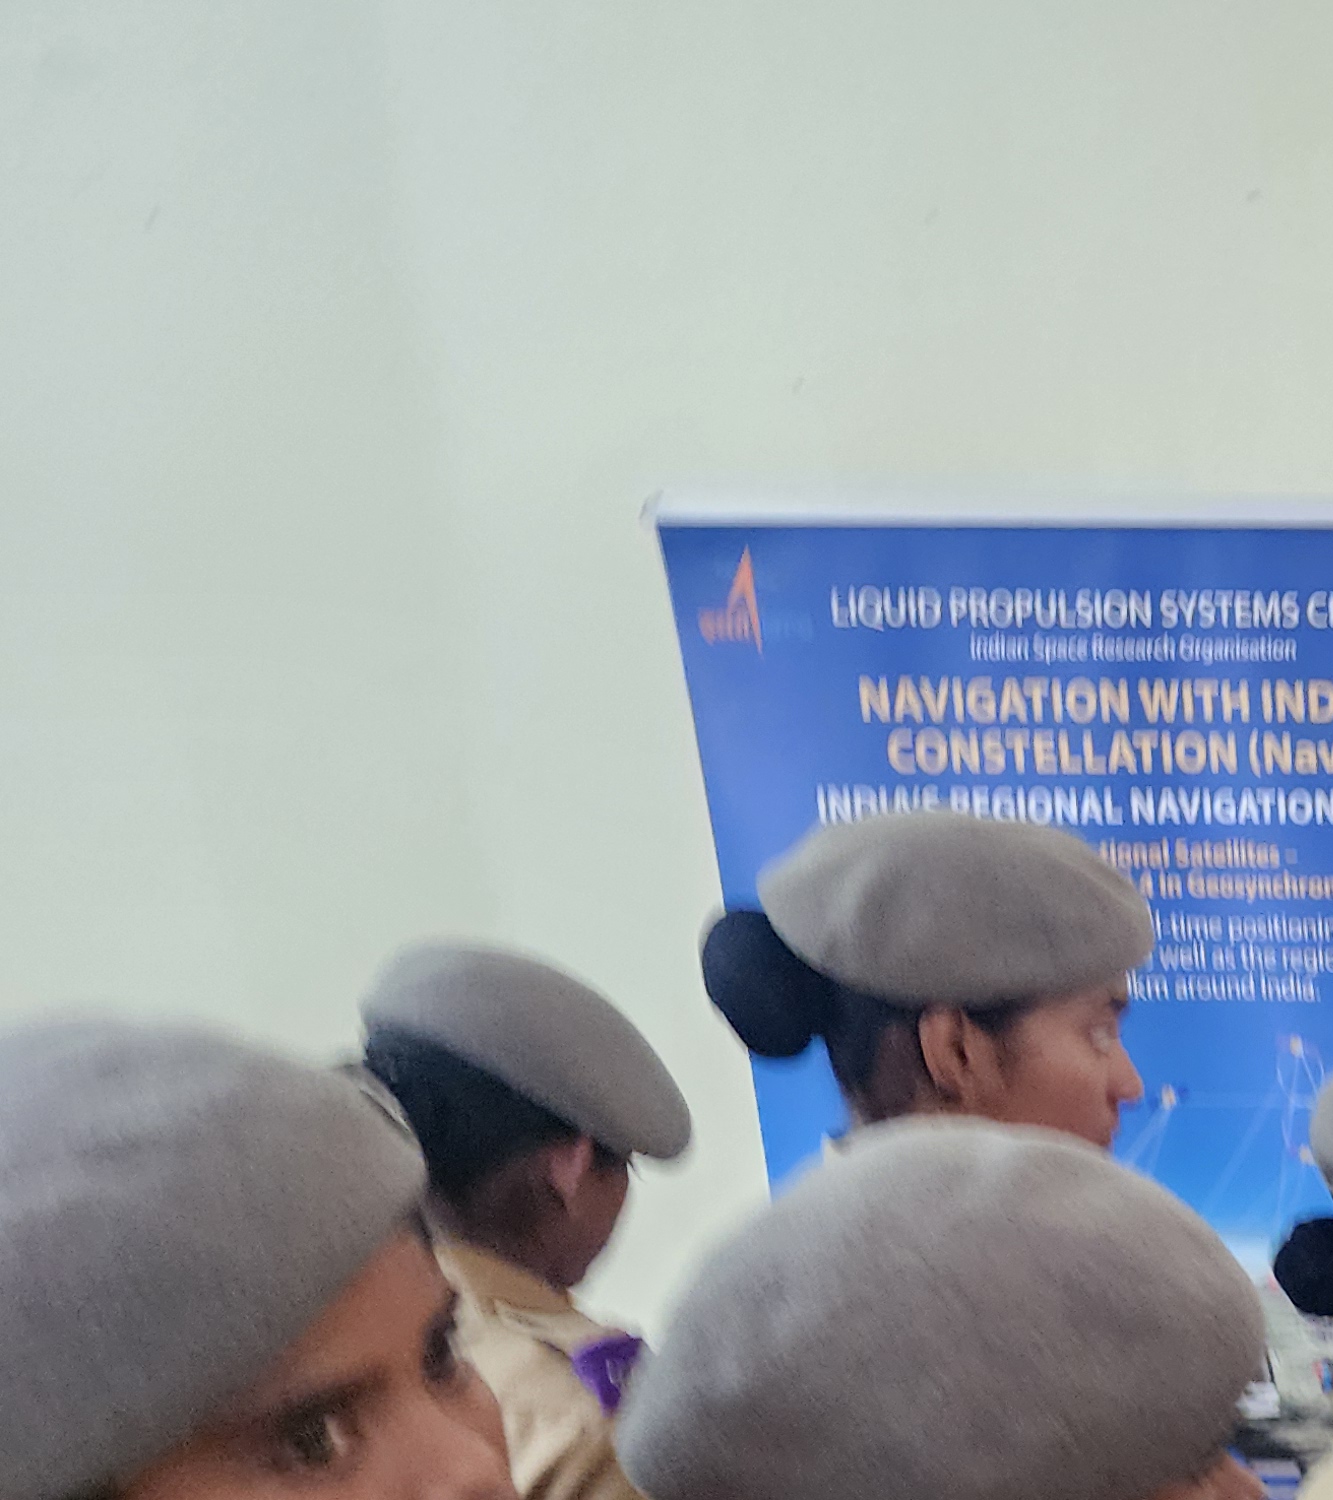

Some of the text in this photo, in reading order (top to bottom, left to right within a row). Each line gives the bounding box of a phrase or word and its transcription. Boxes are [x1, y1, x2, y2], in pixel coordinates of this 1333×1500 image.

[829, 584, 943, 632] LIQUID
[948, 584, 1153, 630] PROPULSION
[1160, 588, 1300, 630] SYSTEMS
[969, 631, 1297, 666] Indian Space Research Organisation
[858, 674, 1130, 725] NAVIGATION
[1137, 677, 1250, 724] WITH
[886, 726, 1238, 776] CONSTELLATION
[949, 783, 1124, 827] REGIONAL
[1174, 836, 1281, 870] Satellites
[1149, 908, 1223, 943] l-time
[1157, 937, 1207, 972] well
[1240, 938, 1277, 972] the
[1174, 969, 1256, 1002] around
